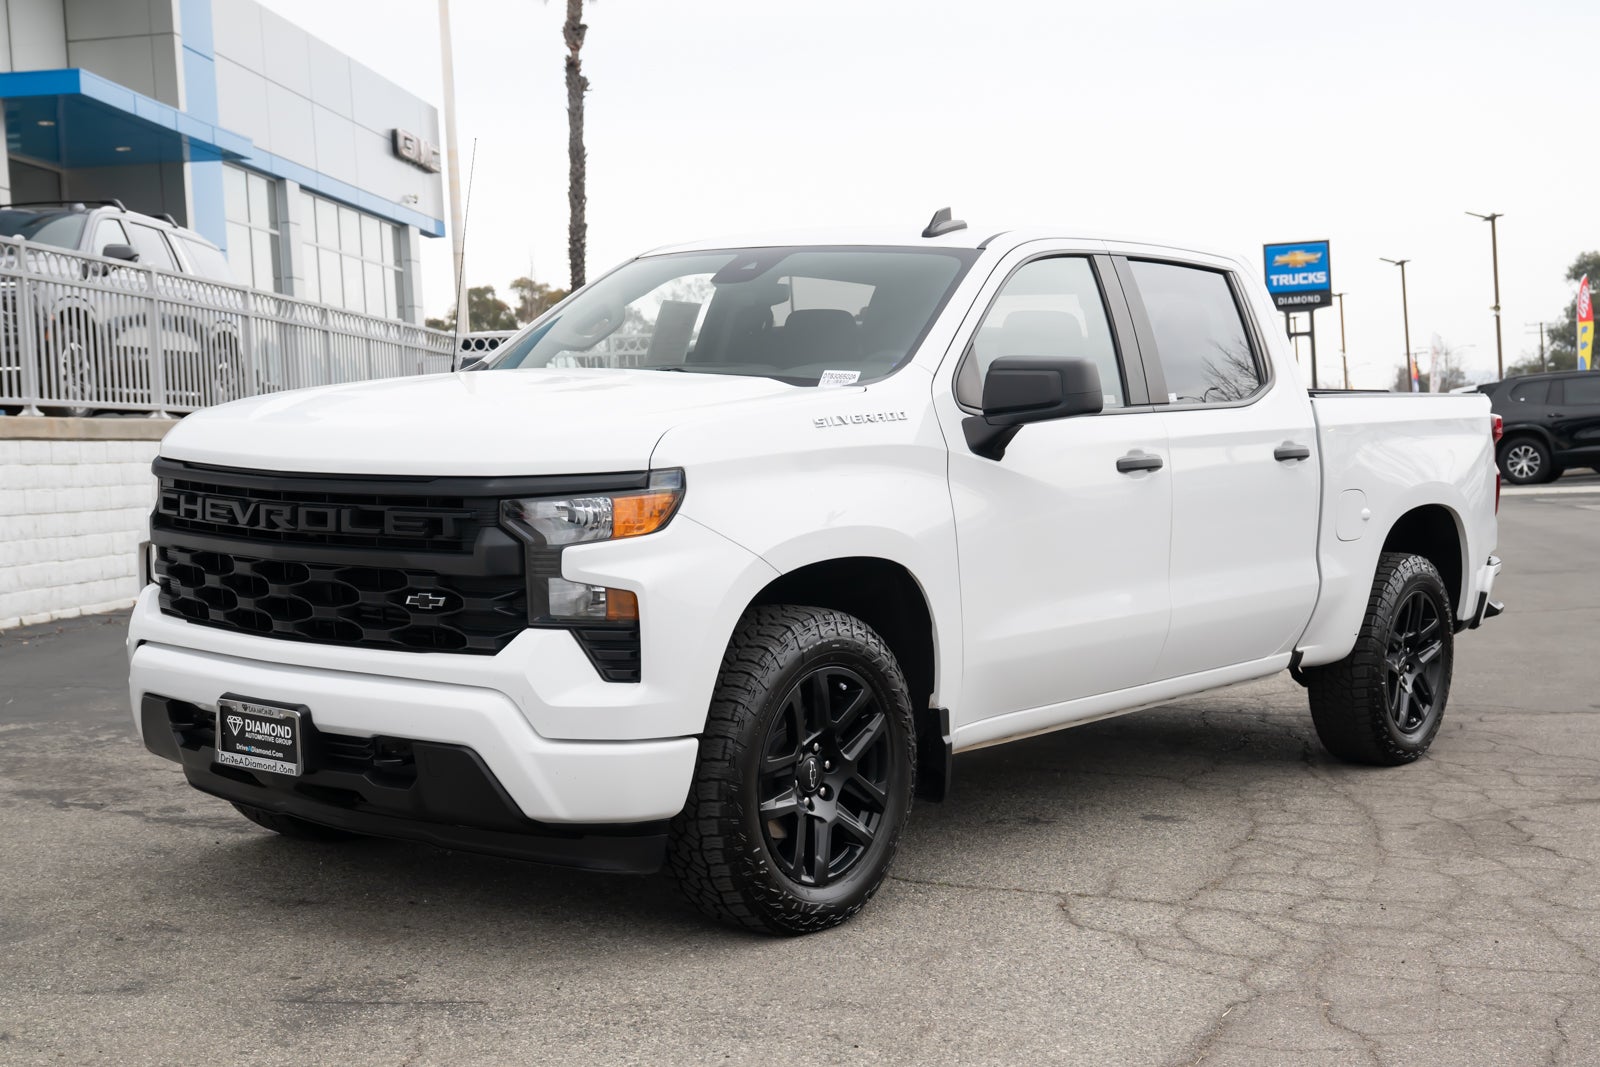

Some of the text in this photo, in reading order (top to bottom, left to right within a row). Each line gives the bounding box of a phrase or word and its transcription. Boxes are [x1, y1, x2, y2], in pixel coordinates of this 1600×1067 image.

[1270, 271, 1327, 286] TRUCKS
[1277, 294, 1321, 305] DIAMOND
[813, 411, 908, 429] SILVERADO
[157, 490, 477, 538] CHEVROLET
[245, 718, 292, 739] DIAMOND
[245, 732, 292, 745] AUTOMOTIVE GROUP
